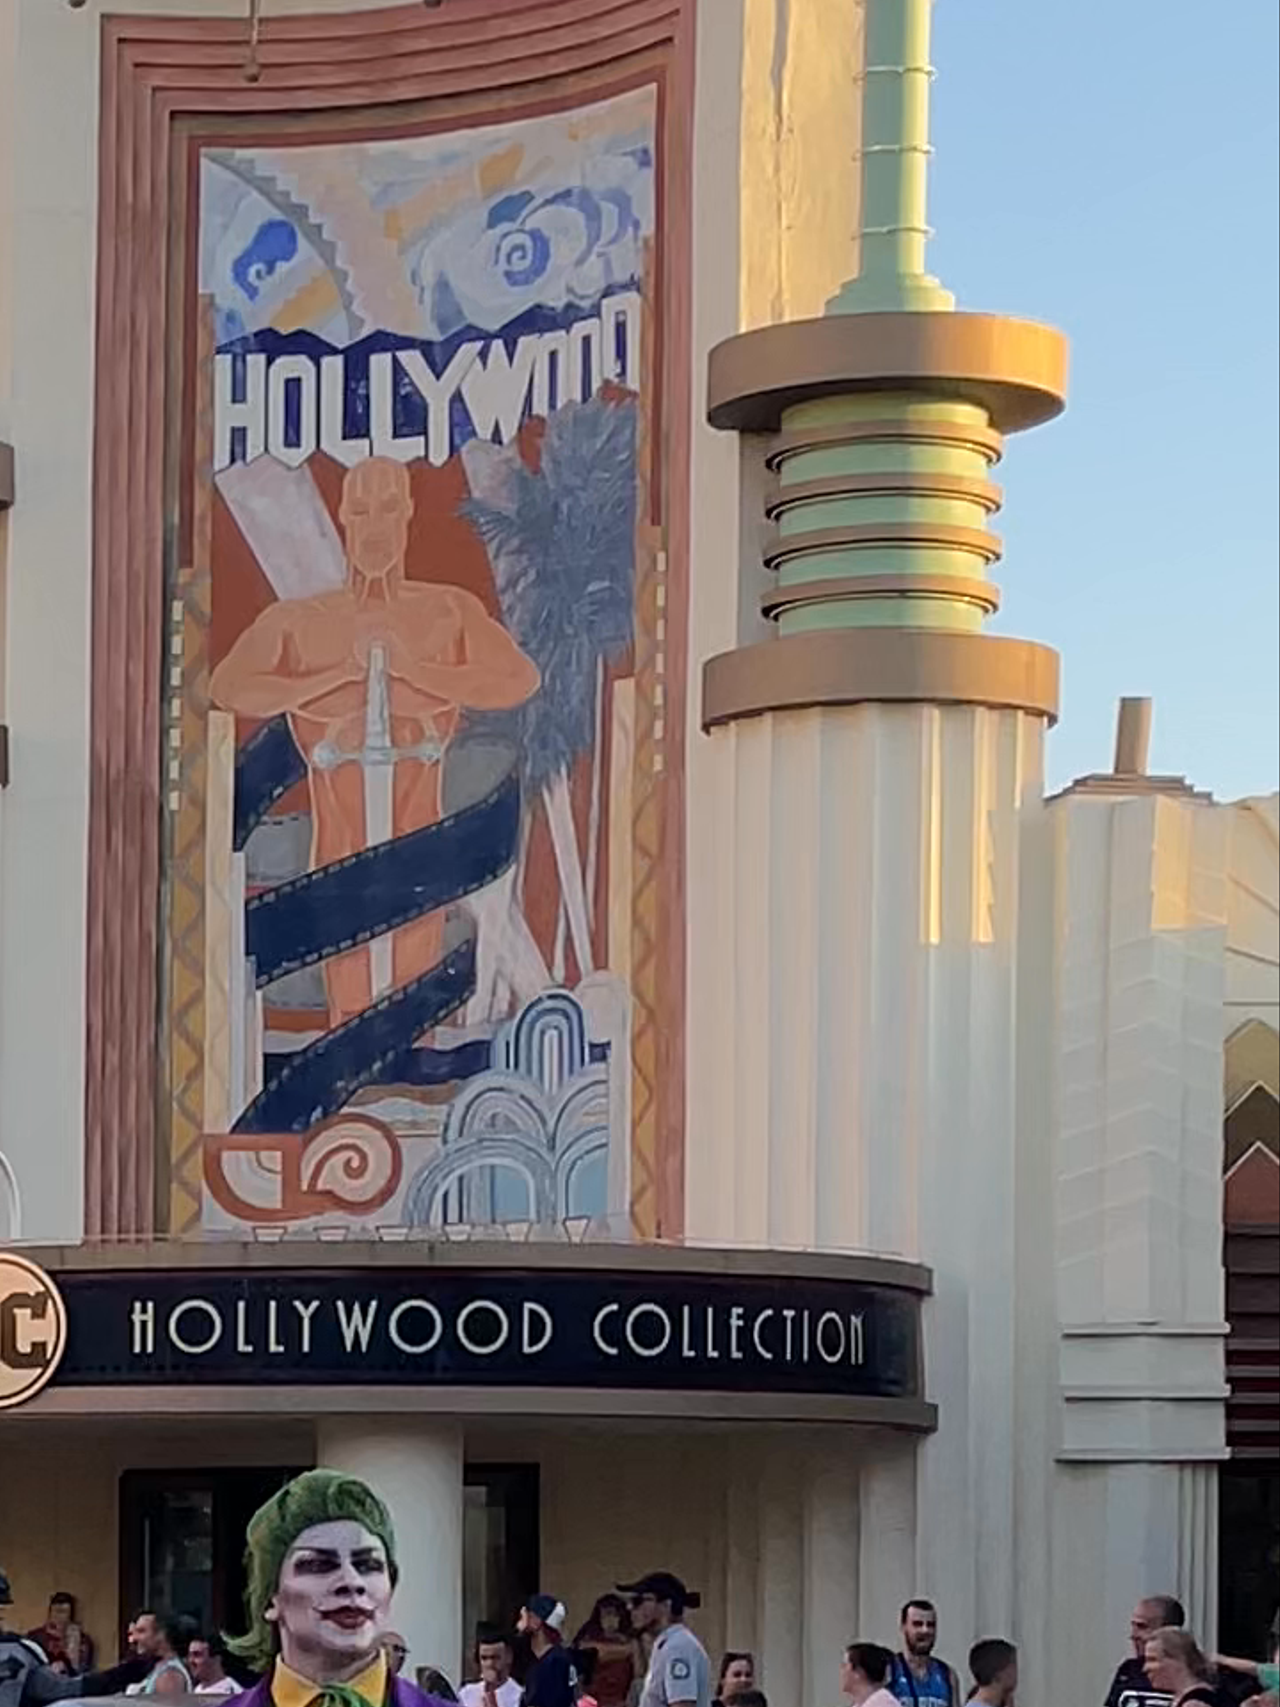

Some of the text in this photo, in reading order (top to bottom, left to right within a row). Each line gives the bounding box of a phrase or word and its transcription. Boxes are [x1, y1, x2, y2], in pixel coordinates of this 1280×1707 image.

[214, 292, 640, 471] HOLLYWOOD
[131, 1298, 866, 1366] HOLLYWOOD COLLECTION
